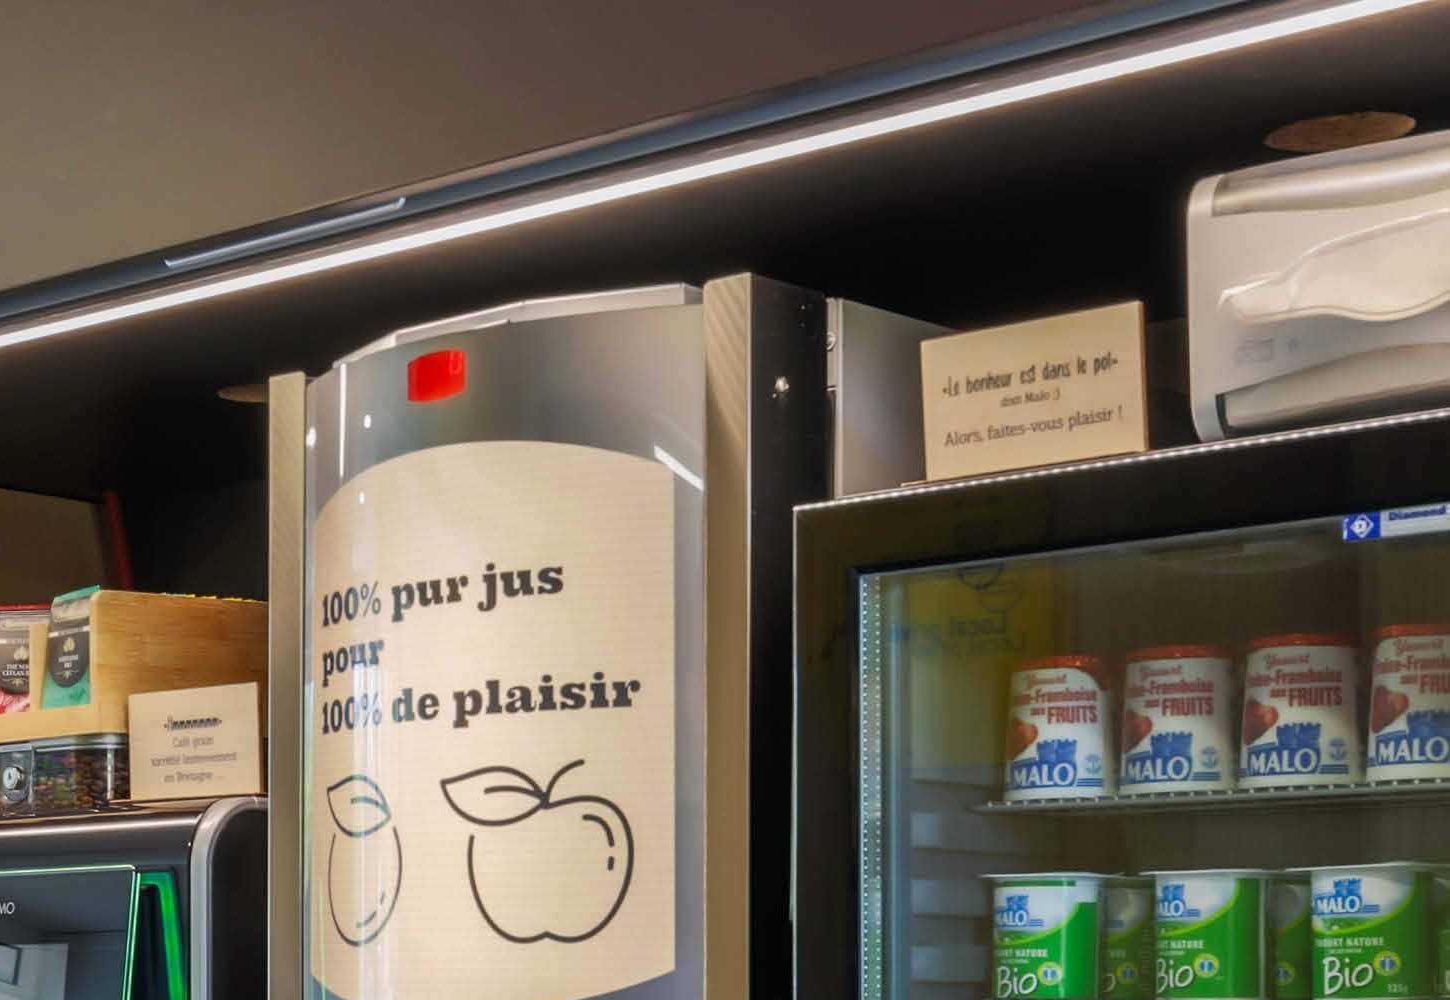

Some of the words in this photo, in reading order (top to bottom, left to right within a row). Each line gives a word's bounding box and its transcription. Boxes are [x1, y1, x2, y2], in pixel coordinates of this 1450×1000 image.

[965, 370, 1012, 394] bonheur
[1019, 364, 1036, 385] est
[1042, 361, 1071, 381] dans
[1077, 355, 1087, 375] le
[986, 416, 1064, 441] faites-vous
[1068, 408, 1114, 431] plaisir
[322, 581, 382, 627] 100%
[391, 574, 469, 623] pur
[477, 562, 564, 612] jus
[322, 638, 384, 688] pour
[322, 691, 382, 735] 100%
[391, 687, 440, 723] de
[452, 671, 641, 729] plaisir
[1161, 697, 1215, 717] FRUITS
[1288, 686, 1342, 708] FRUITS
[1047, 704, 1098, 725] FRUITS
[1250, 747, 1318, 774] MALO
[1378, 736, 1450, 763] MALO
[1013, 762, 1075, 786] MALO
[1127, 755, 1190, 781] MALO
[1317, 895, 1361, 913] MALO
[1345, 936, 1385, 946] NATURE
[996, 966, 1038, 998] Bio
[1322, 956, 1374, 996] Bio
